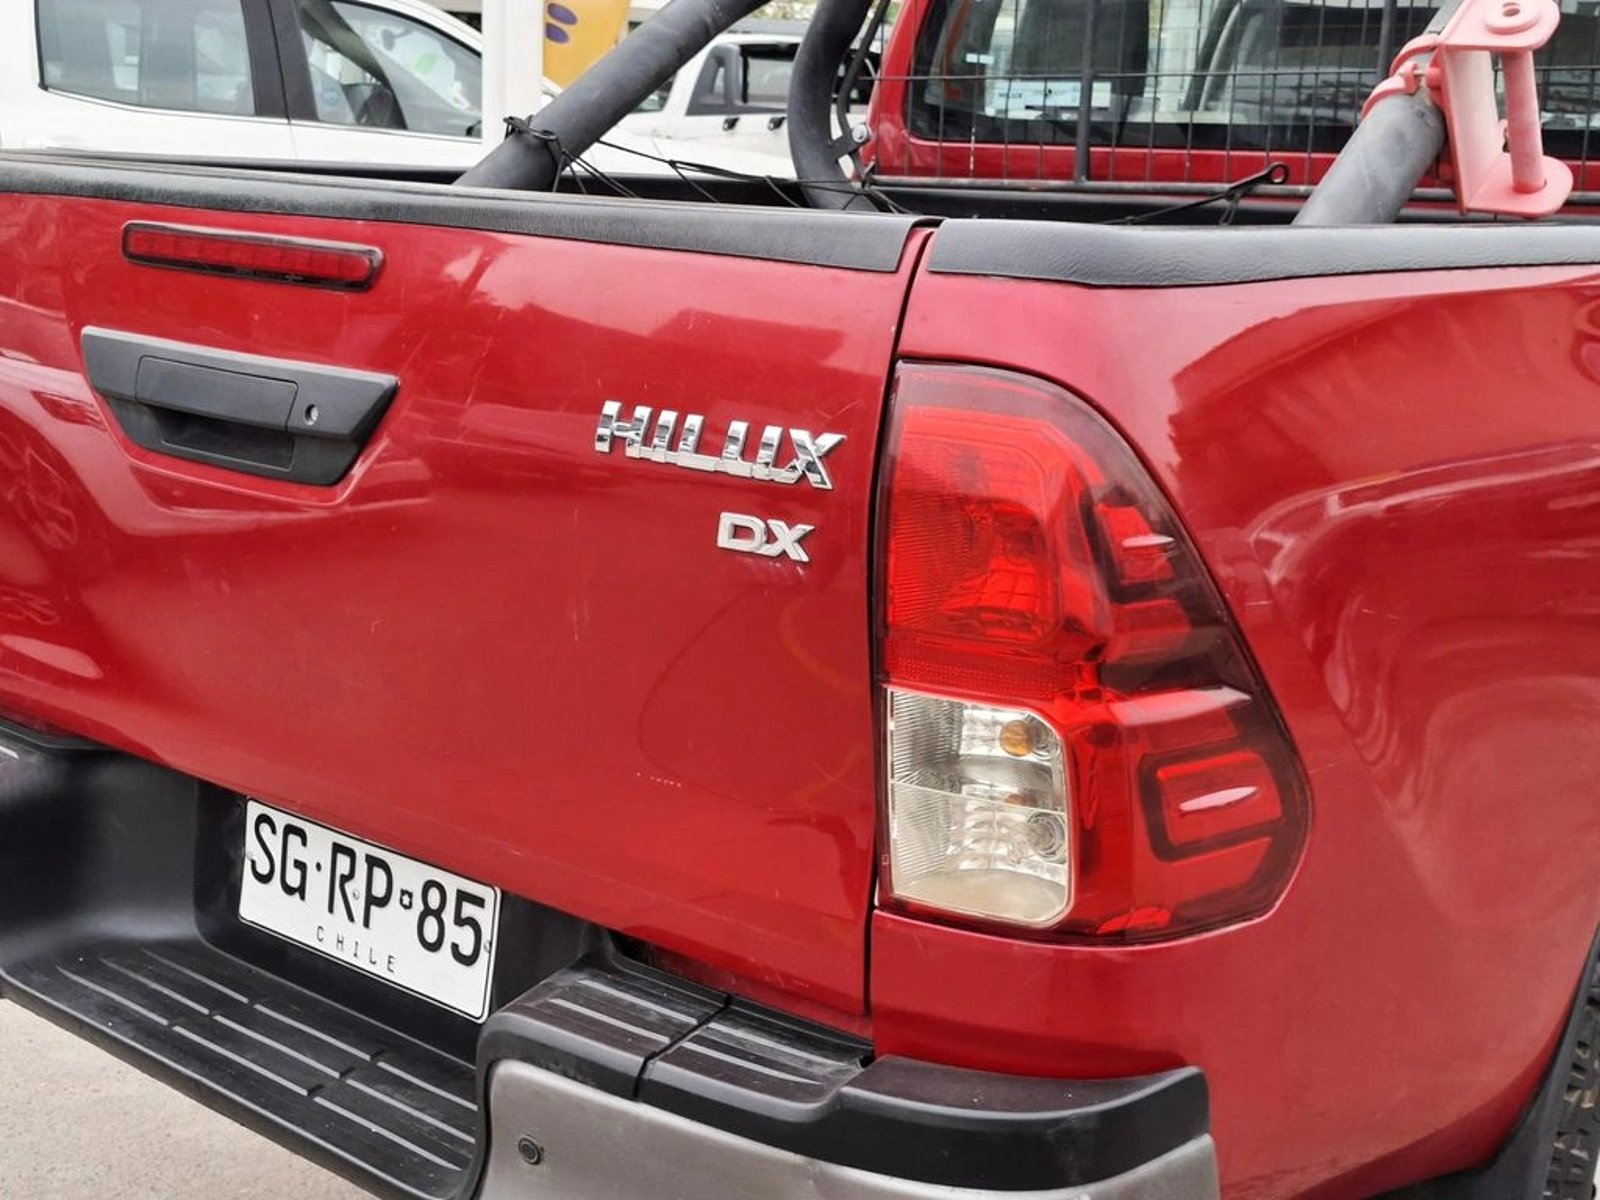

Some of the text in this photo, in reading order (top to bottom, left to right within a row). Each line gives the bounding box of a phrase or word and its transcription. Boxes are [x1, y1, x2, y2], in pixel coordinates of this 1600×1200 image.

[595, 400, 847, 490] HILUX
[717, 512, 815, 562] DX
[316, 926, 396, 973] CHILE
